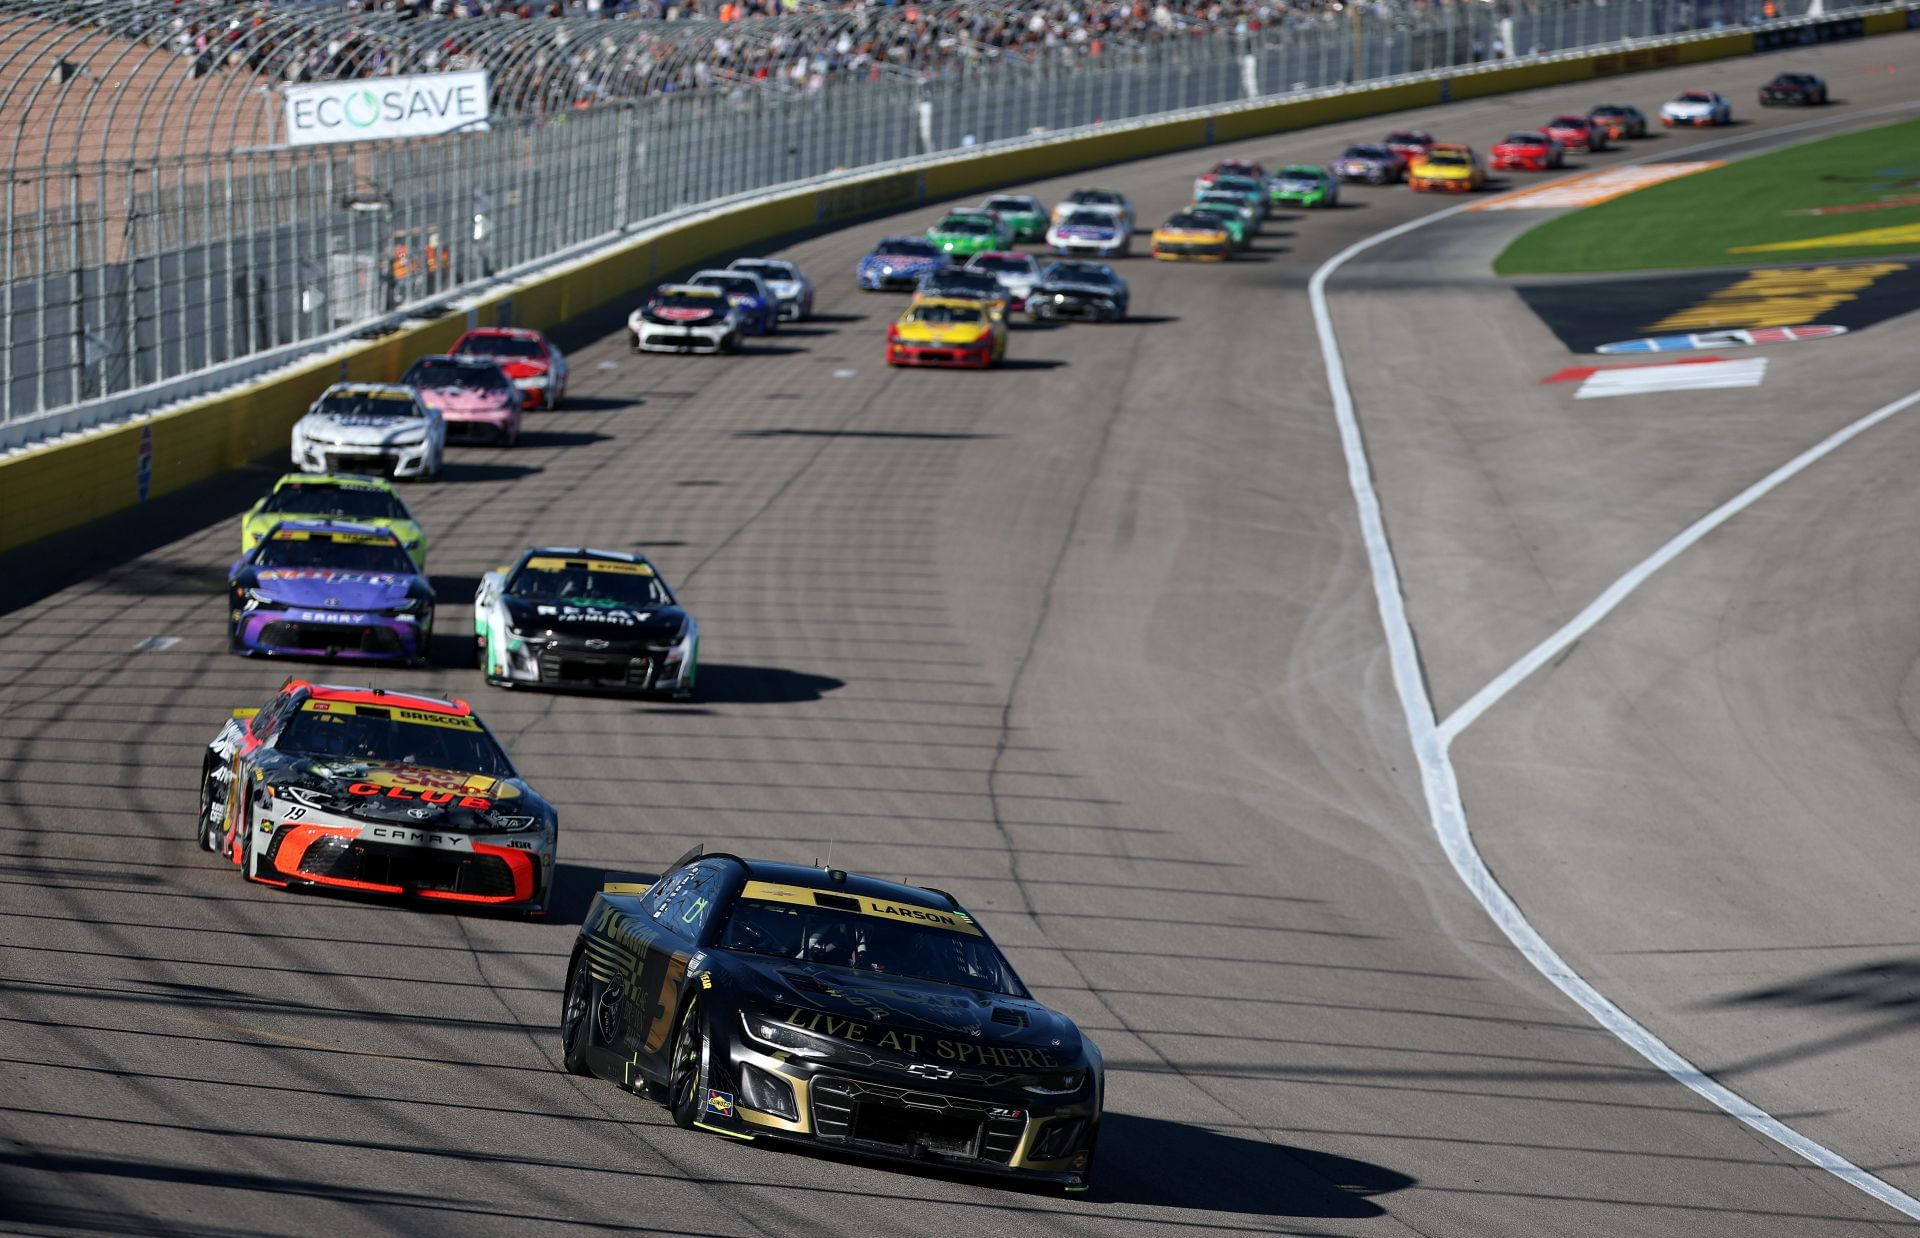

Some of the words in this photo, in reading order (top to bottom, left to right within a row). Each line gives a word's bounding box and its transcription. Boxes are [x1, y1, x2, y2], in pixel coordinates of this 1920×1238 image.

[295, 84, 476, 130] ECOSAVE
[536, 604, 653, 622] RELAY
[557, 613, 636, 627] PAYMENTS
[400, 710, 473, 727] BRISCOE
[348, 780, 493, 810] CLUB
[281, 805, 309, 822] 19
[373, 827, 464, 847] CAMRY
[506, 839, 532, 850] JGR
[871, 903, 956, 926] LARSON
[643, 952, 689, 1054] 5
[784, 1007, 868, 1043] LIVE
[878, 1029, 925, 1055] AT
[935, 1038, 1060, 1069] SPHERE
